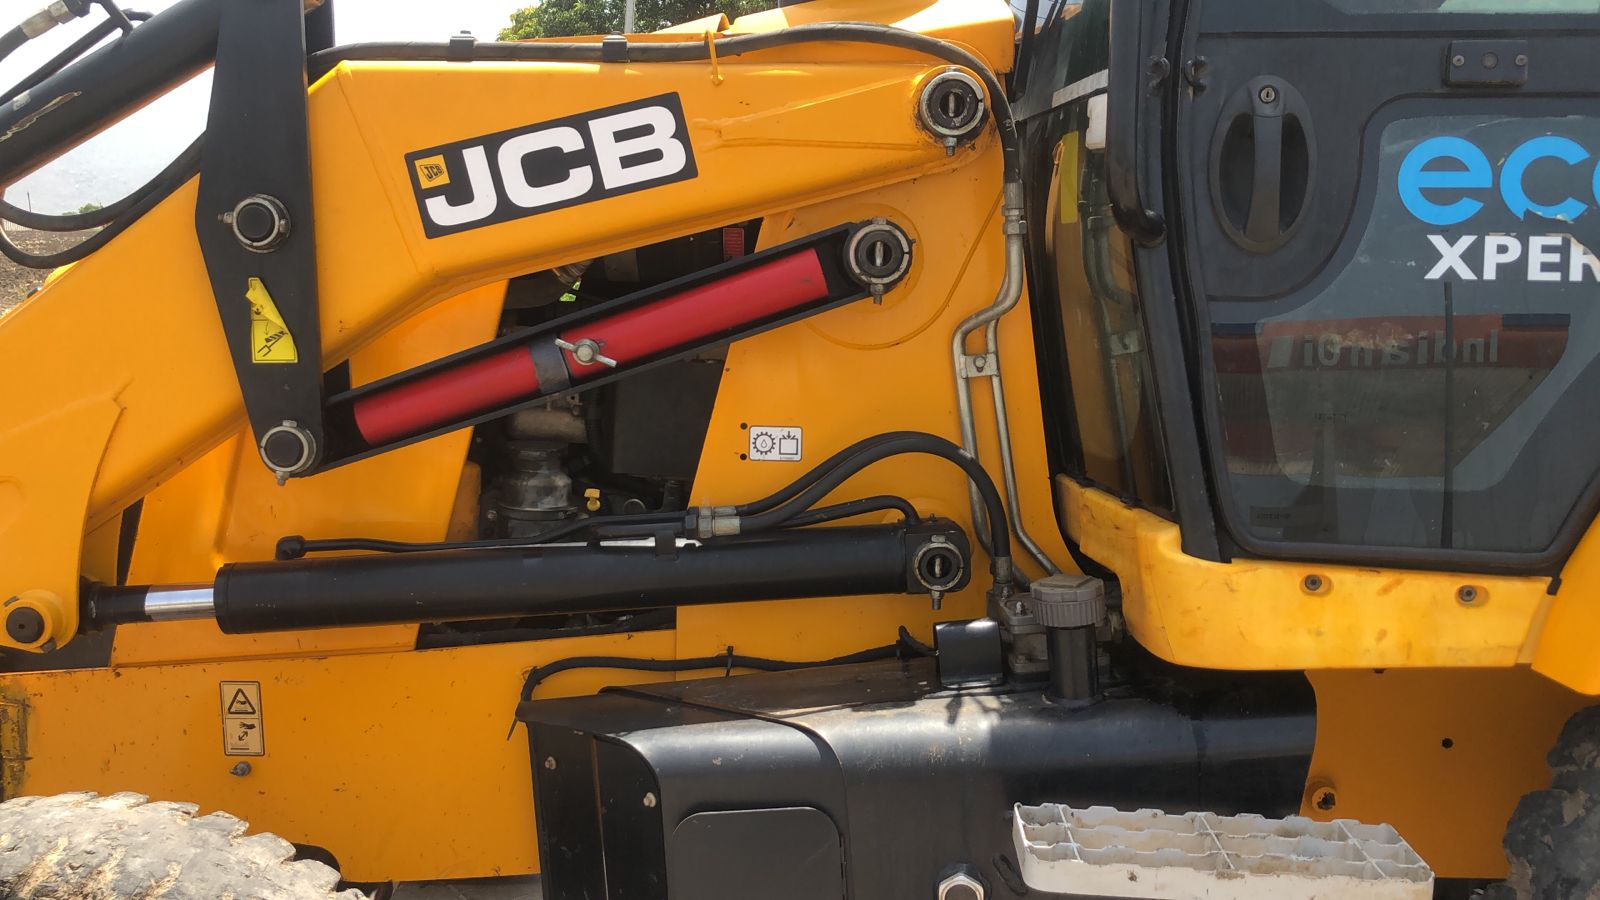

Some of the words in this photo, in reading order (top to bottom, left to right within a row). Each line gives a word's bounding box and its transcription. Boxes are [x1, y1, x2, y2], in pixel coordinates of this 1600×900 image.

[424, 105, 687, 226] JCB
[424, 165, 443, 179] JCB
[1397, 135, 1600, 226] ec
